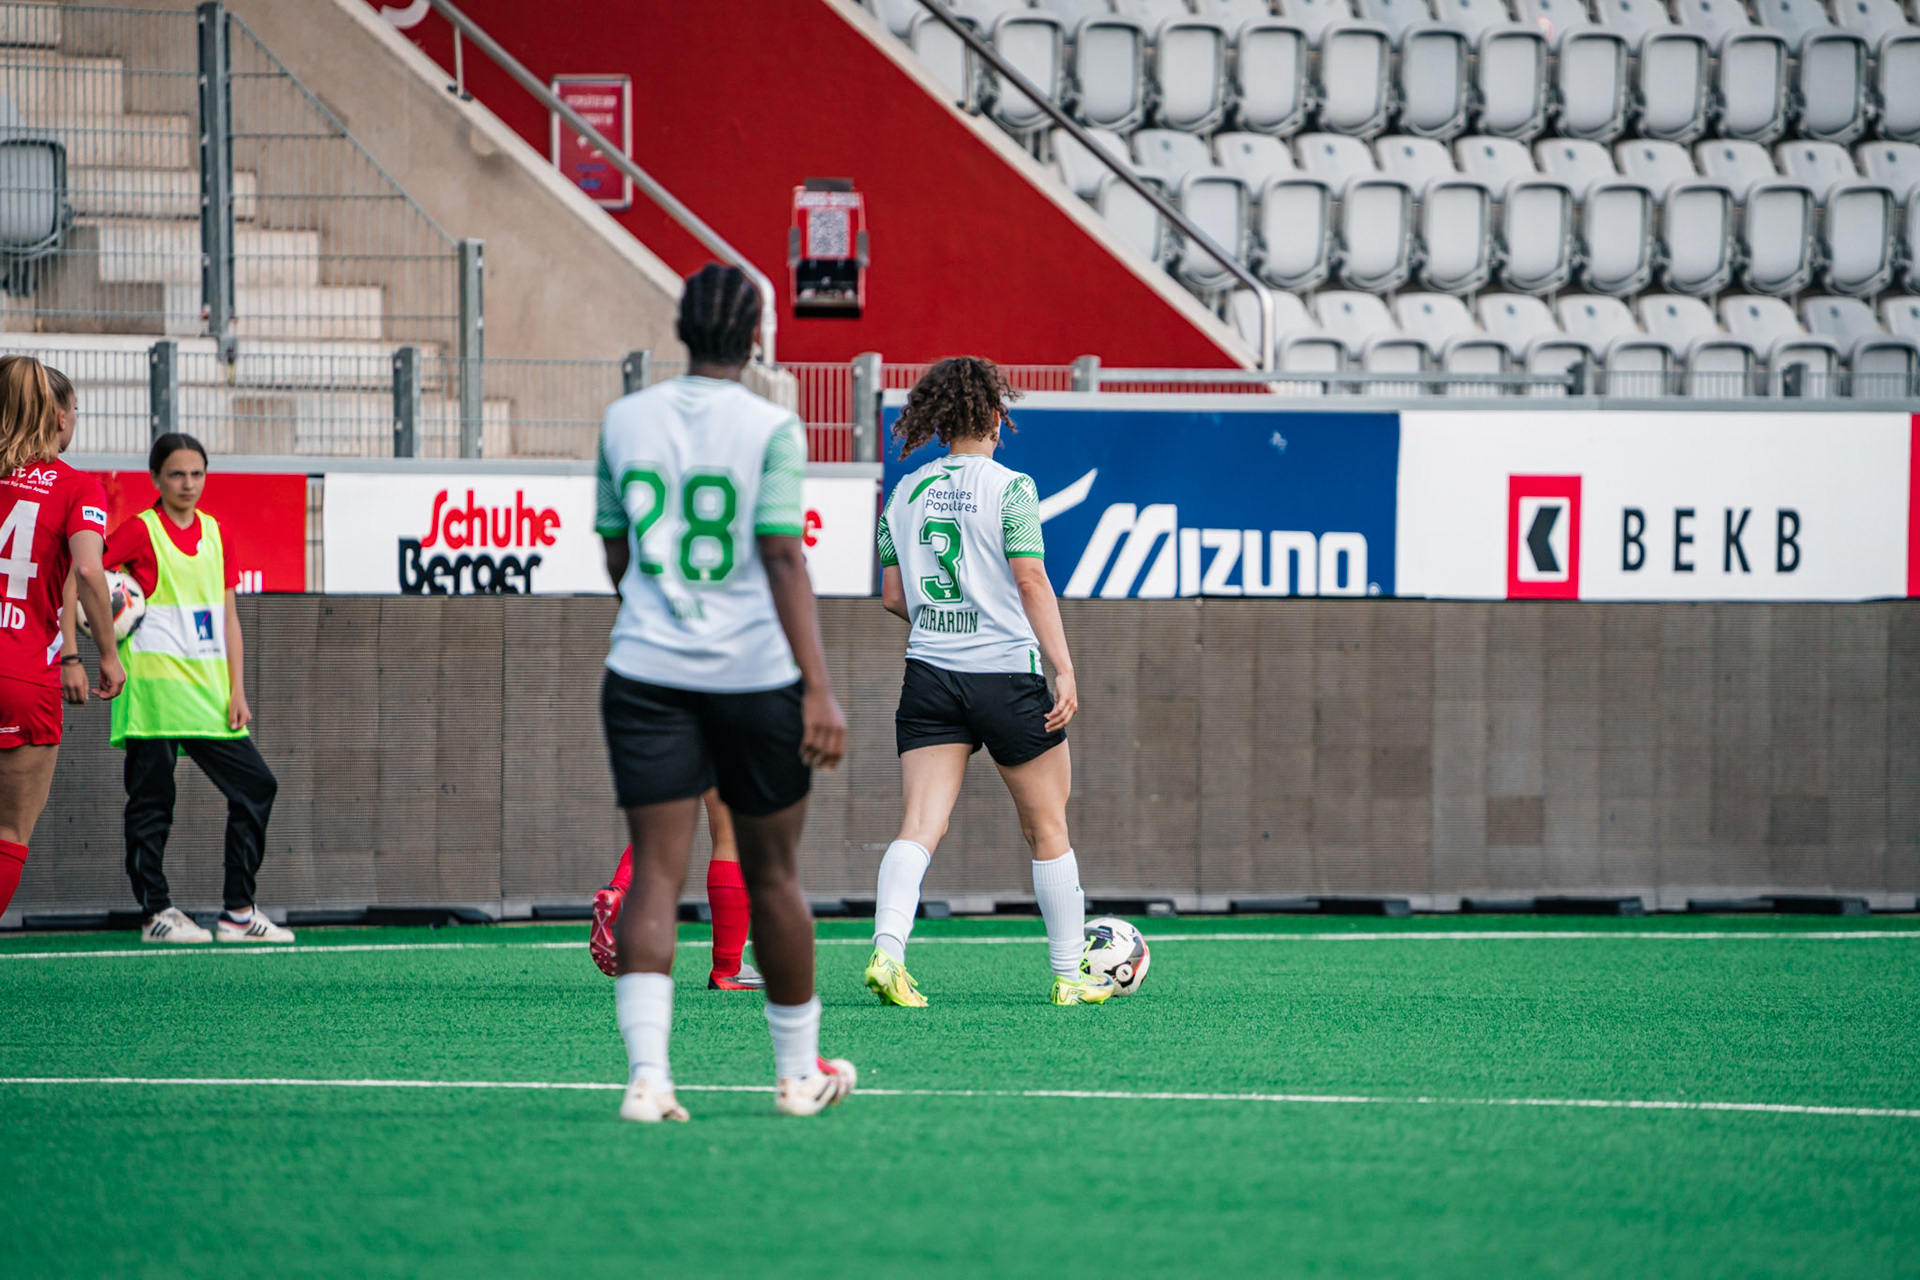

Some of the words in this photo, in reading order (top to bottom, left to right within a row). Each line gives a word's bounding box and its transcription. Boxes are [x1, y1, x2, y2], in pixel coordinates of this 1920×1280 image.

[28, 467, 58, 482] AG
[421, 489, 561, 549] Schuhe
[619, 467, 740, 585] 28
[1621, 508, 1802, 573] BEKB
[398, 537, 542, 594] Berger
[919, 515, 964, 604] 3
[919, 606, 979, 634] GIRARDIN
